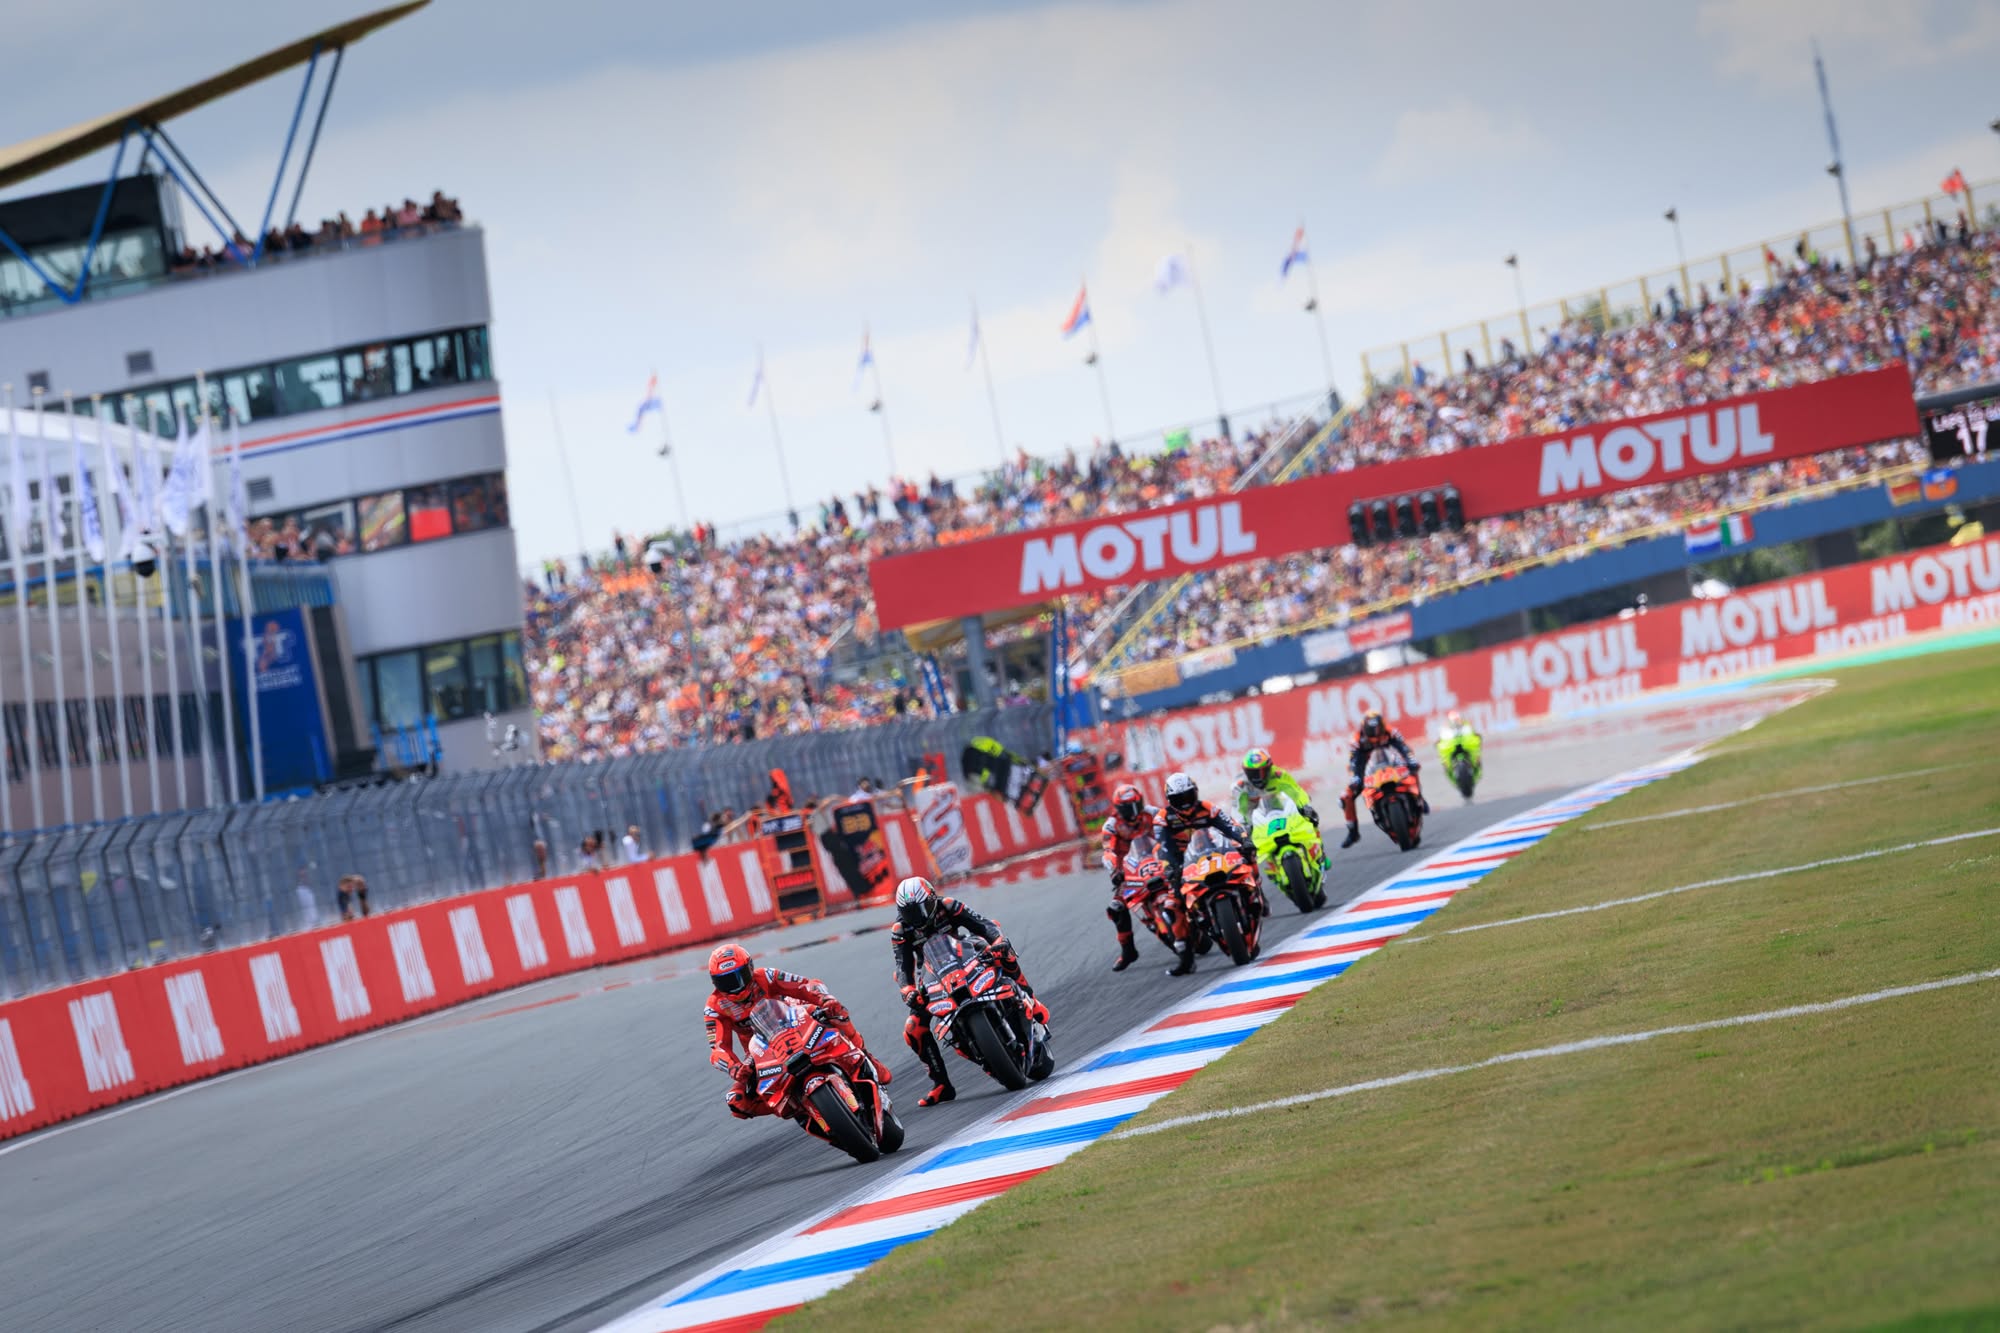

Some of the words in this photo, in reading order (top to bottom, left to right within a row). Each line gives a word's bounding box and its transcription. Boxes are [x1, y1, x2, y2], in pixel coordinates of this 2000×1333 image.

[1538, 402, 1775, 496] MOTUL
[1019, 501, 1257, 595] MOTUL
[1681, 579, 1837, 657] MOTUL
[1491, 622, 1648, 699] MOTUL
[1306, 665, 1458, 736] MOTUL
[1125, 701, 1276, 773] MOTUL
[1200, 857, 1222, 875] 37
[759, 1066, 782, 1077] Lenovo
[806, 1026, 823, 1049] Lenovo
